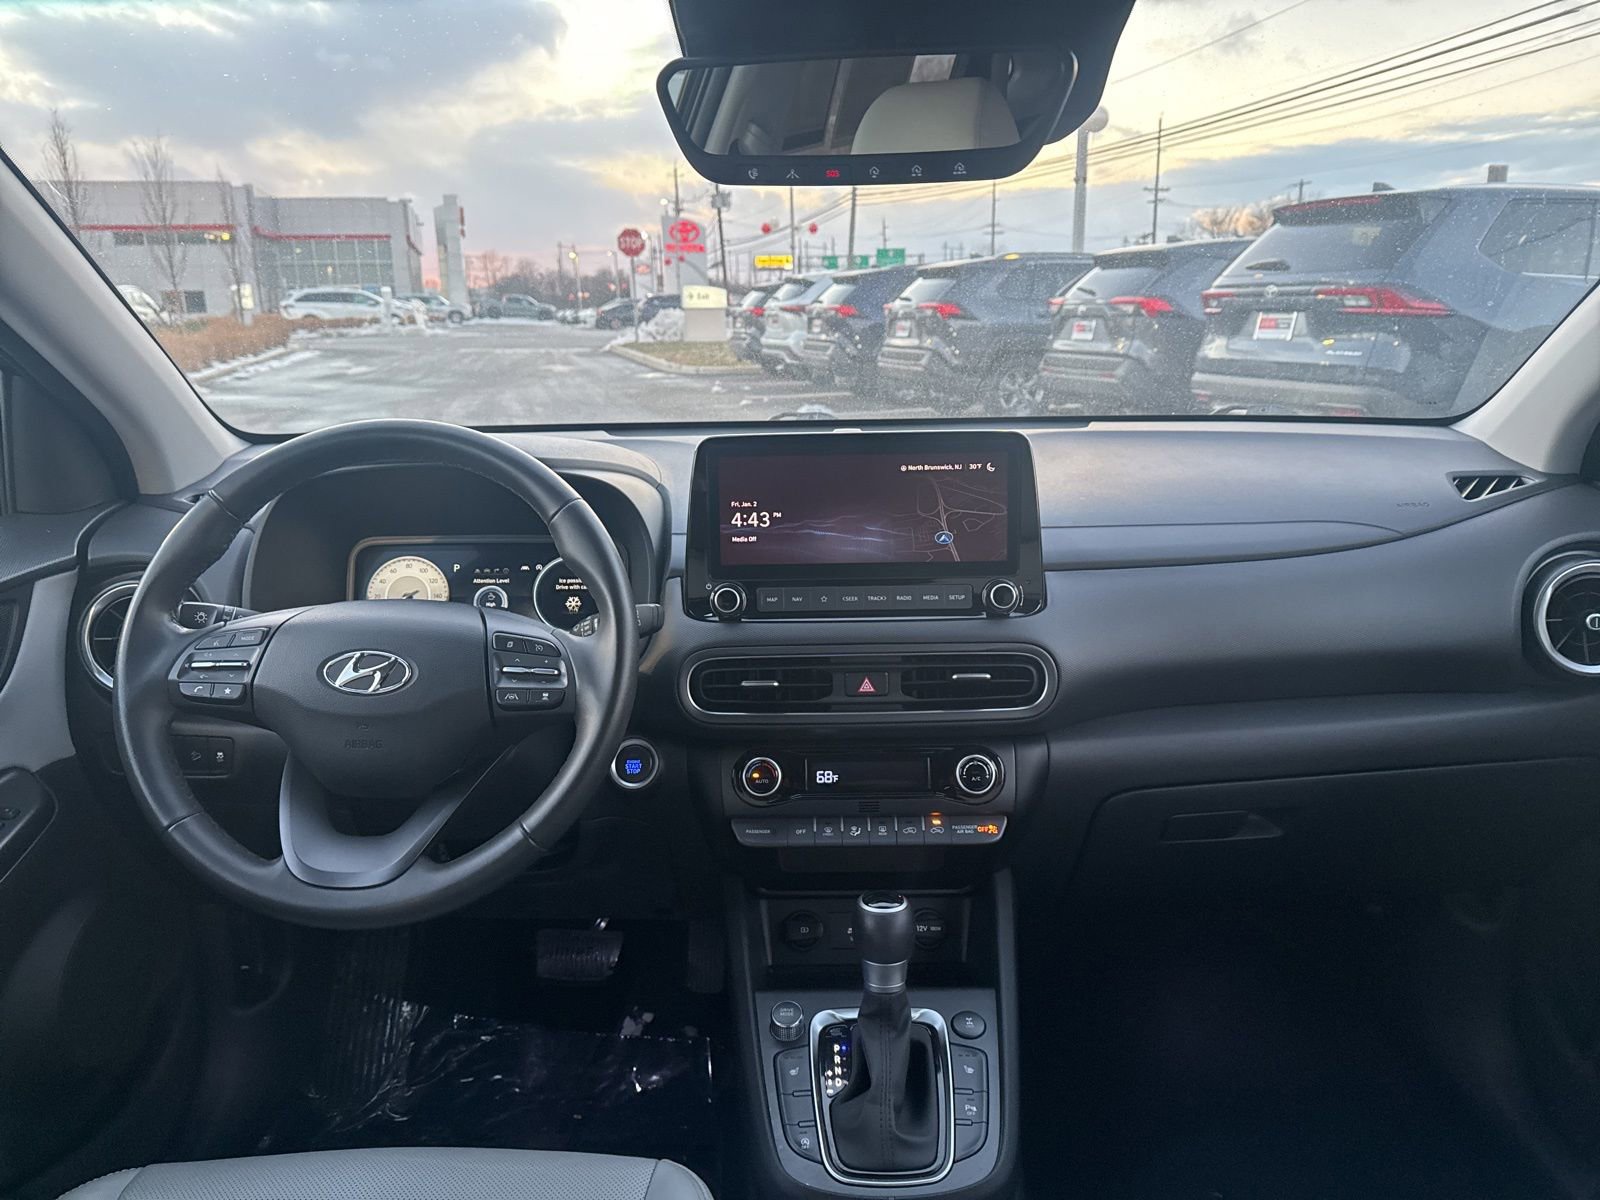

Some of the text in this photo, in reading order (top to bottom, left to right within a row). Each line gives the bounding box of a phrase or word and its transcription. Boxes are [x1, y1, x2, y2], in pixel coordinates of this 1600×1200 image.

[826, 169, 840, 177] SOS
[619, 236, 643, 249] STOP
[924, 463, 954, 471] Brunswick,
[731, 511, 770, 528] 4:43
[453, 563, 461, 573] P
[833, 1044, 841, 1053] P
[834, 1055, 841, 1064] R
[834, 1066, 842, 1075] N
[835, 1077, 842, 1087] D
